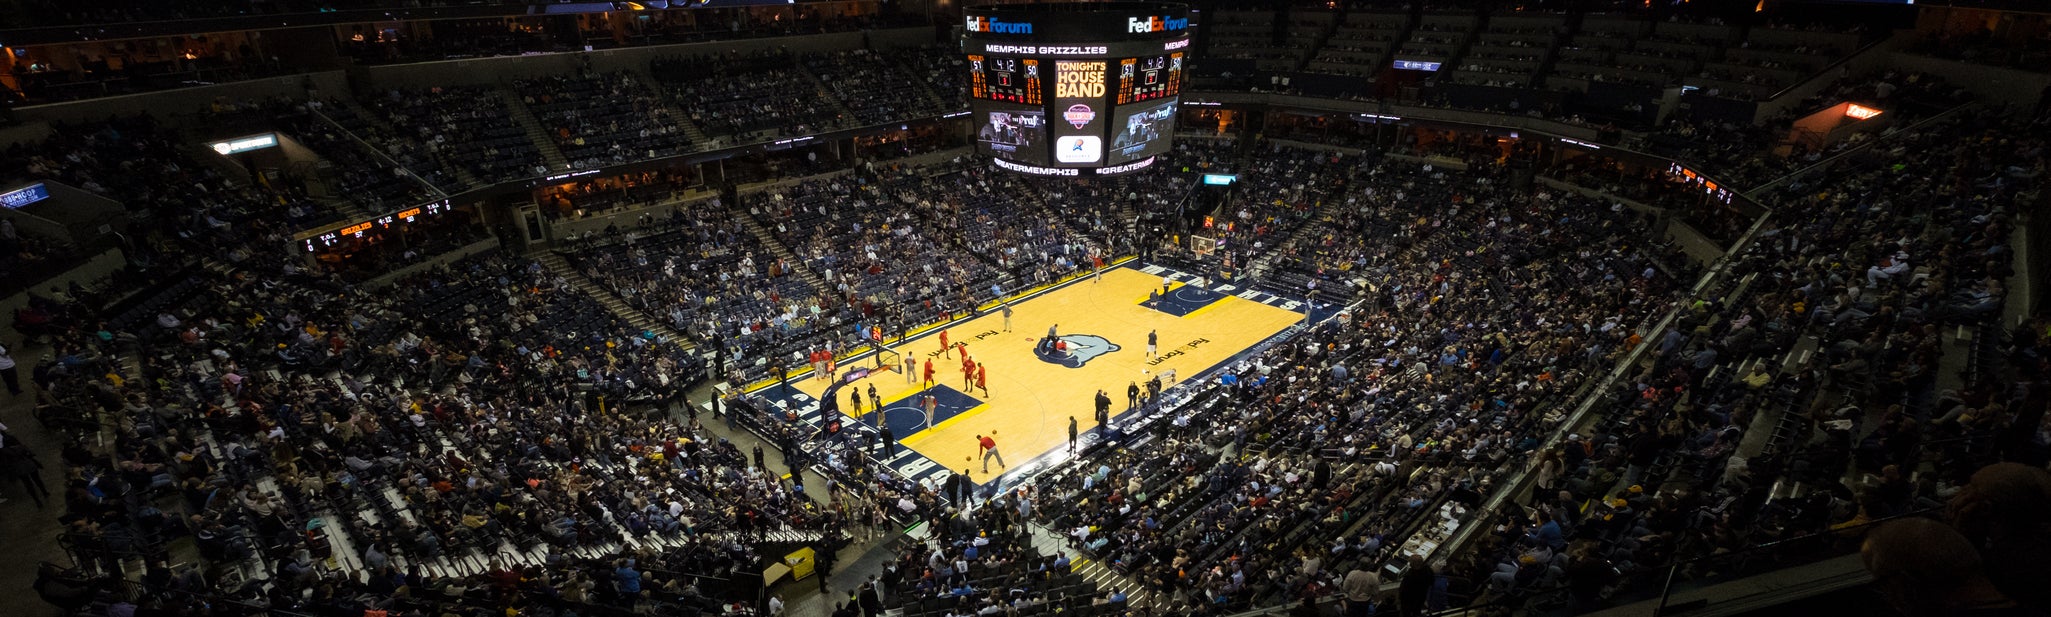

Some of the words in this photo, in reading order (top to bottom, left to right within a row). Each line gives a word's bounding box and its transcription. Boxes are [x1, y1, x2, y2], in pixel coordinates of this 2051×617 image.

[966, 15, 1033, 34] FedExForum
[1128, 15, 1188, 33] FedExForum
[985, 44, 1036, 54] MEMPHIS
[1038, 46, 1108, 55] GRIZZLIES
[1056, 62, 1107, 71] TONIGHT'S
[1057, 72, 1105, 84] HOUSE
[1056, 83, 1106, 98] BAND
[341, 221, 373, 236] GRIZZLIES
